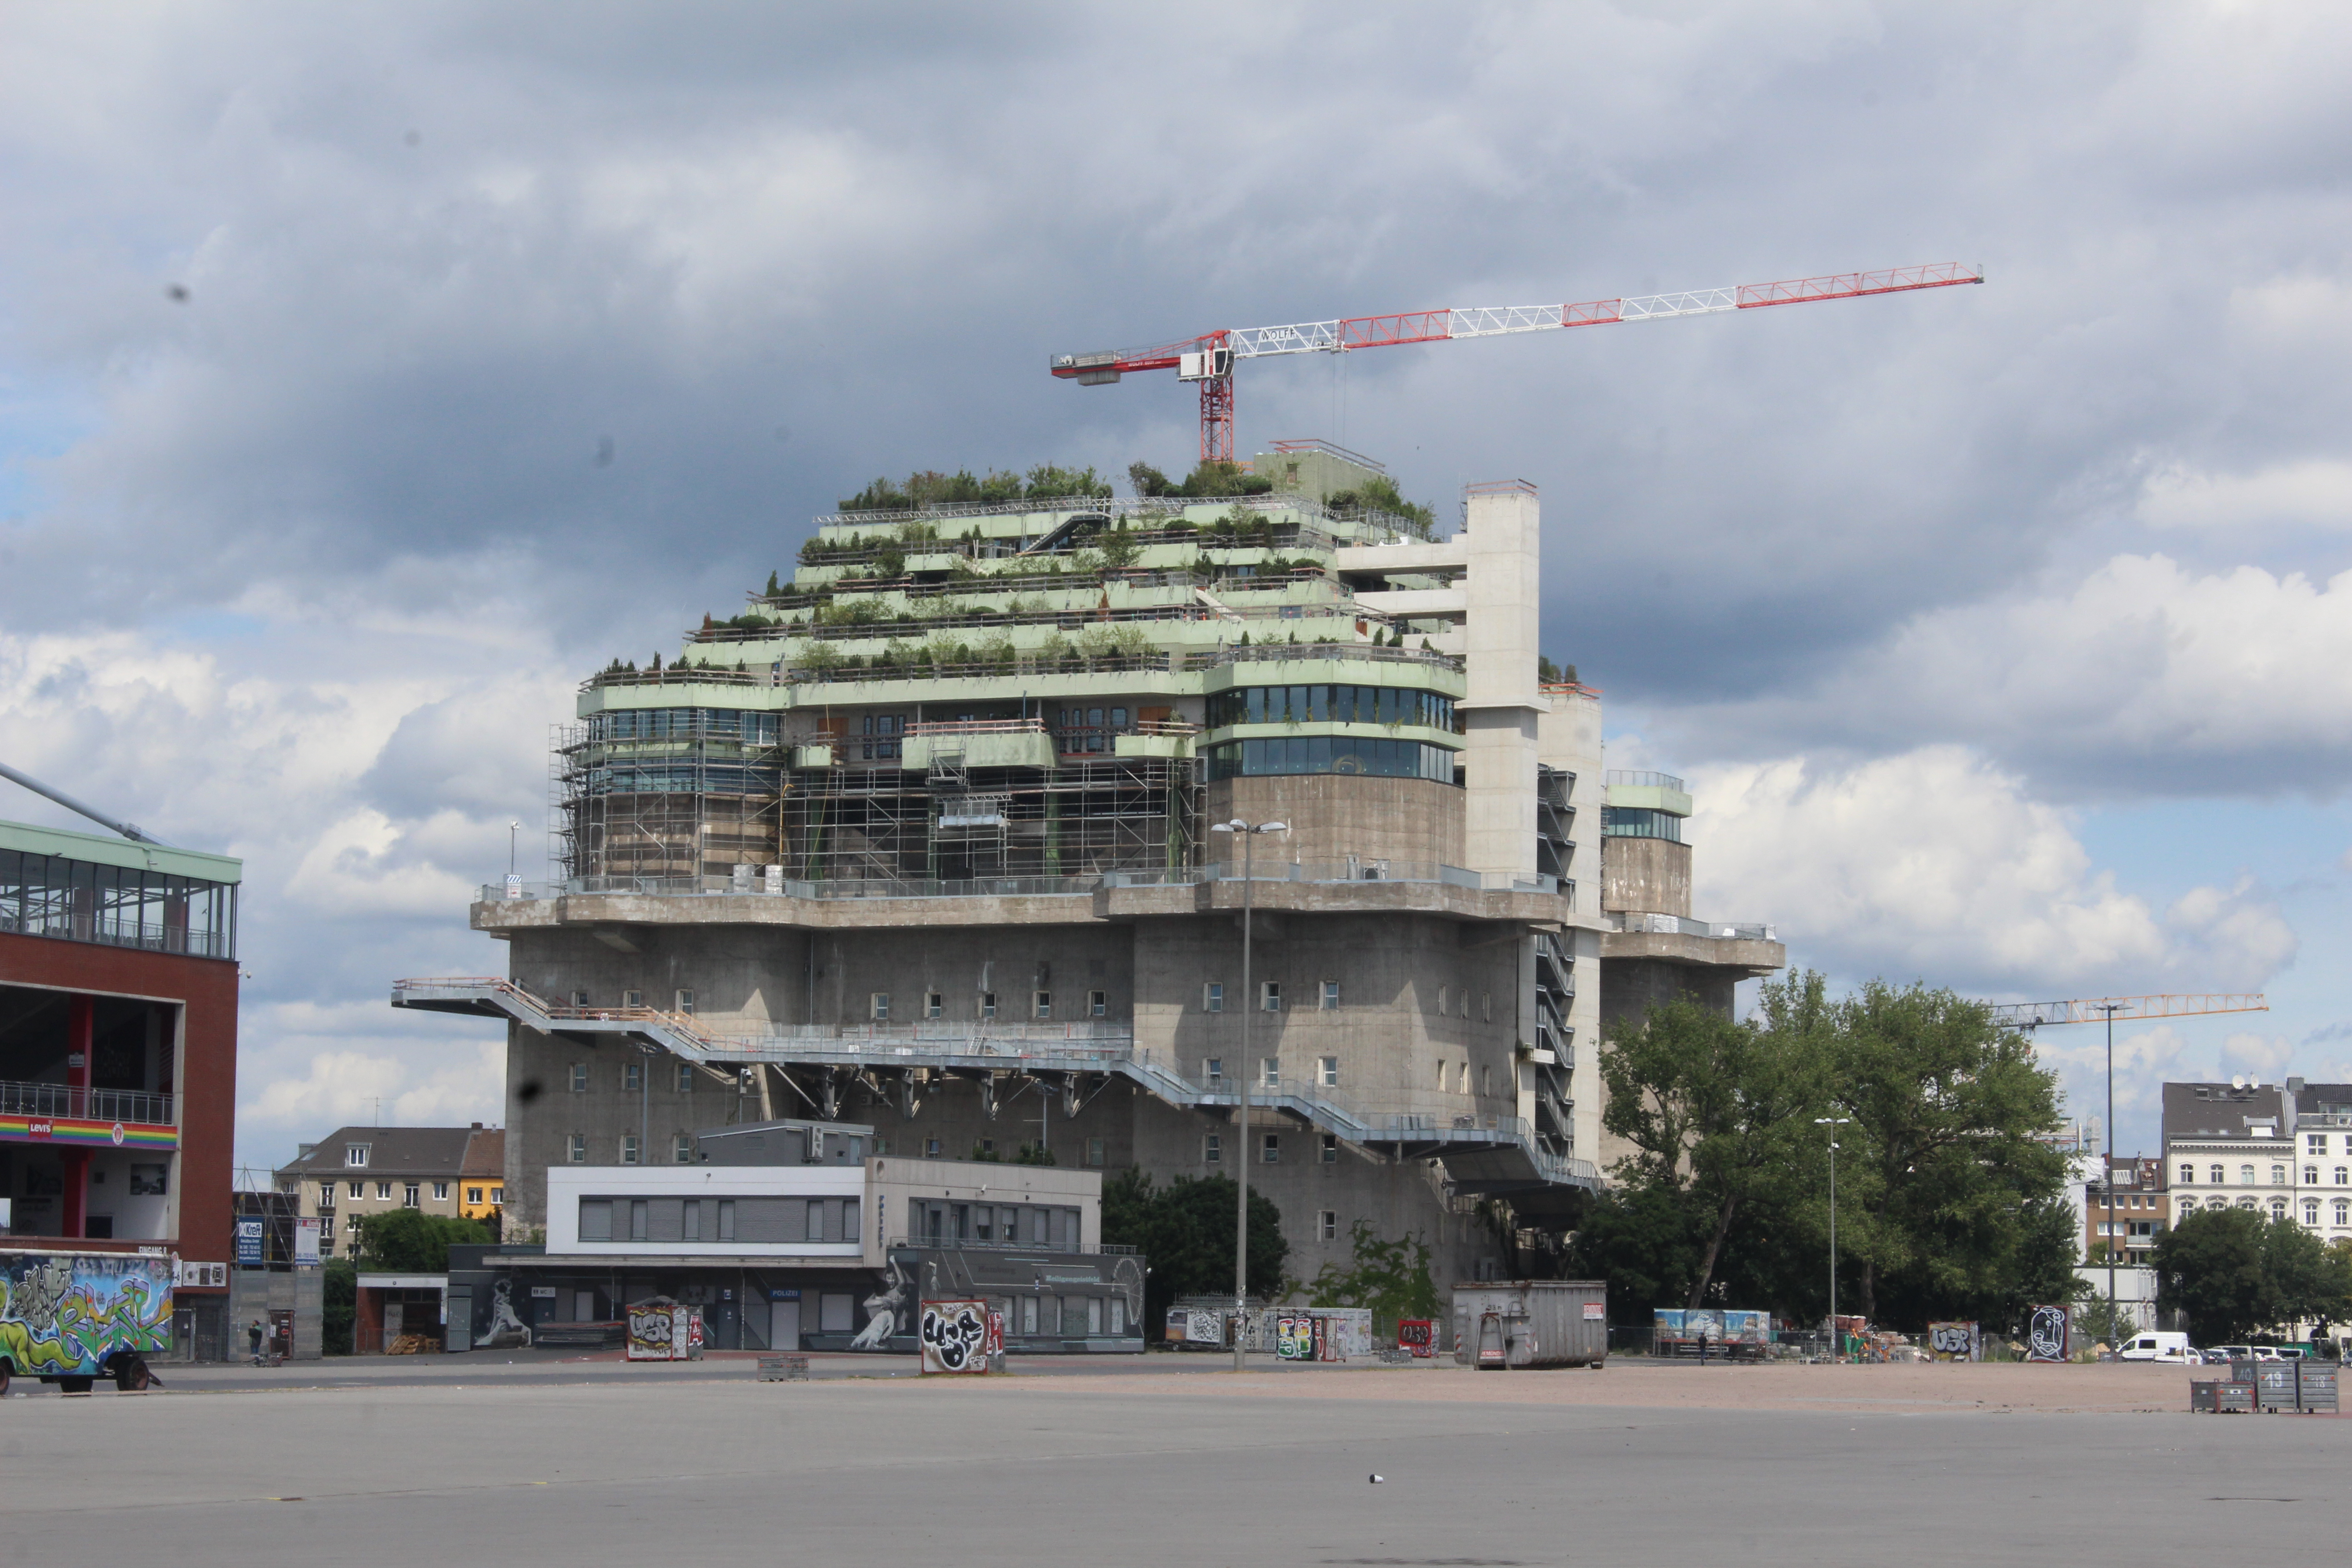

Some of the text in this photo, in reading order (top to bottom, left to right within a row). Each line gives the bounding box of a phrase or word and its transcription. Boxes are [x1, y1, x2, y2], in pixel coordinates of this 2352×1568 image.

[1261, 328, 1295, 340] WOLFF
[246, 1224, 260, 1236] Kreft
[1931, 1328, 1970, 1353] USP
[2264, 1371, 2282, 1389] 19
